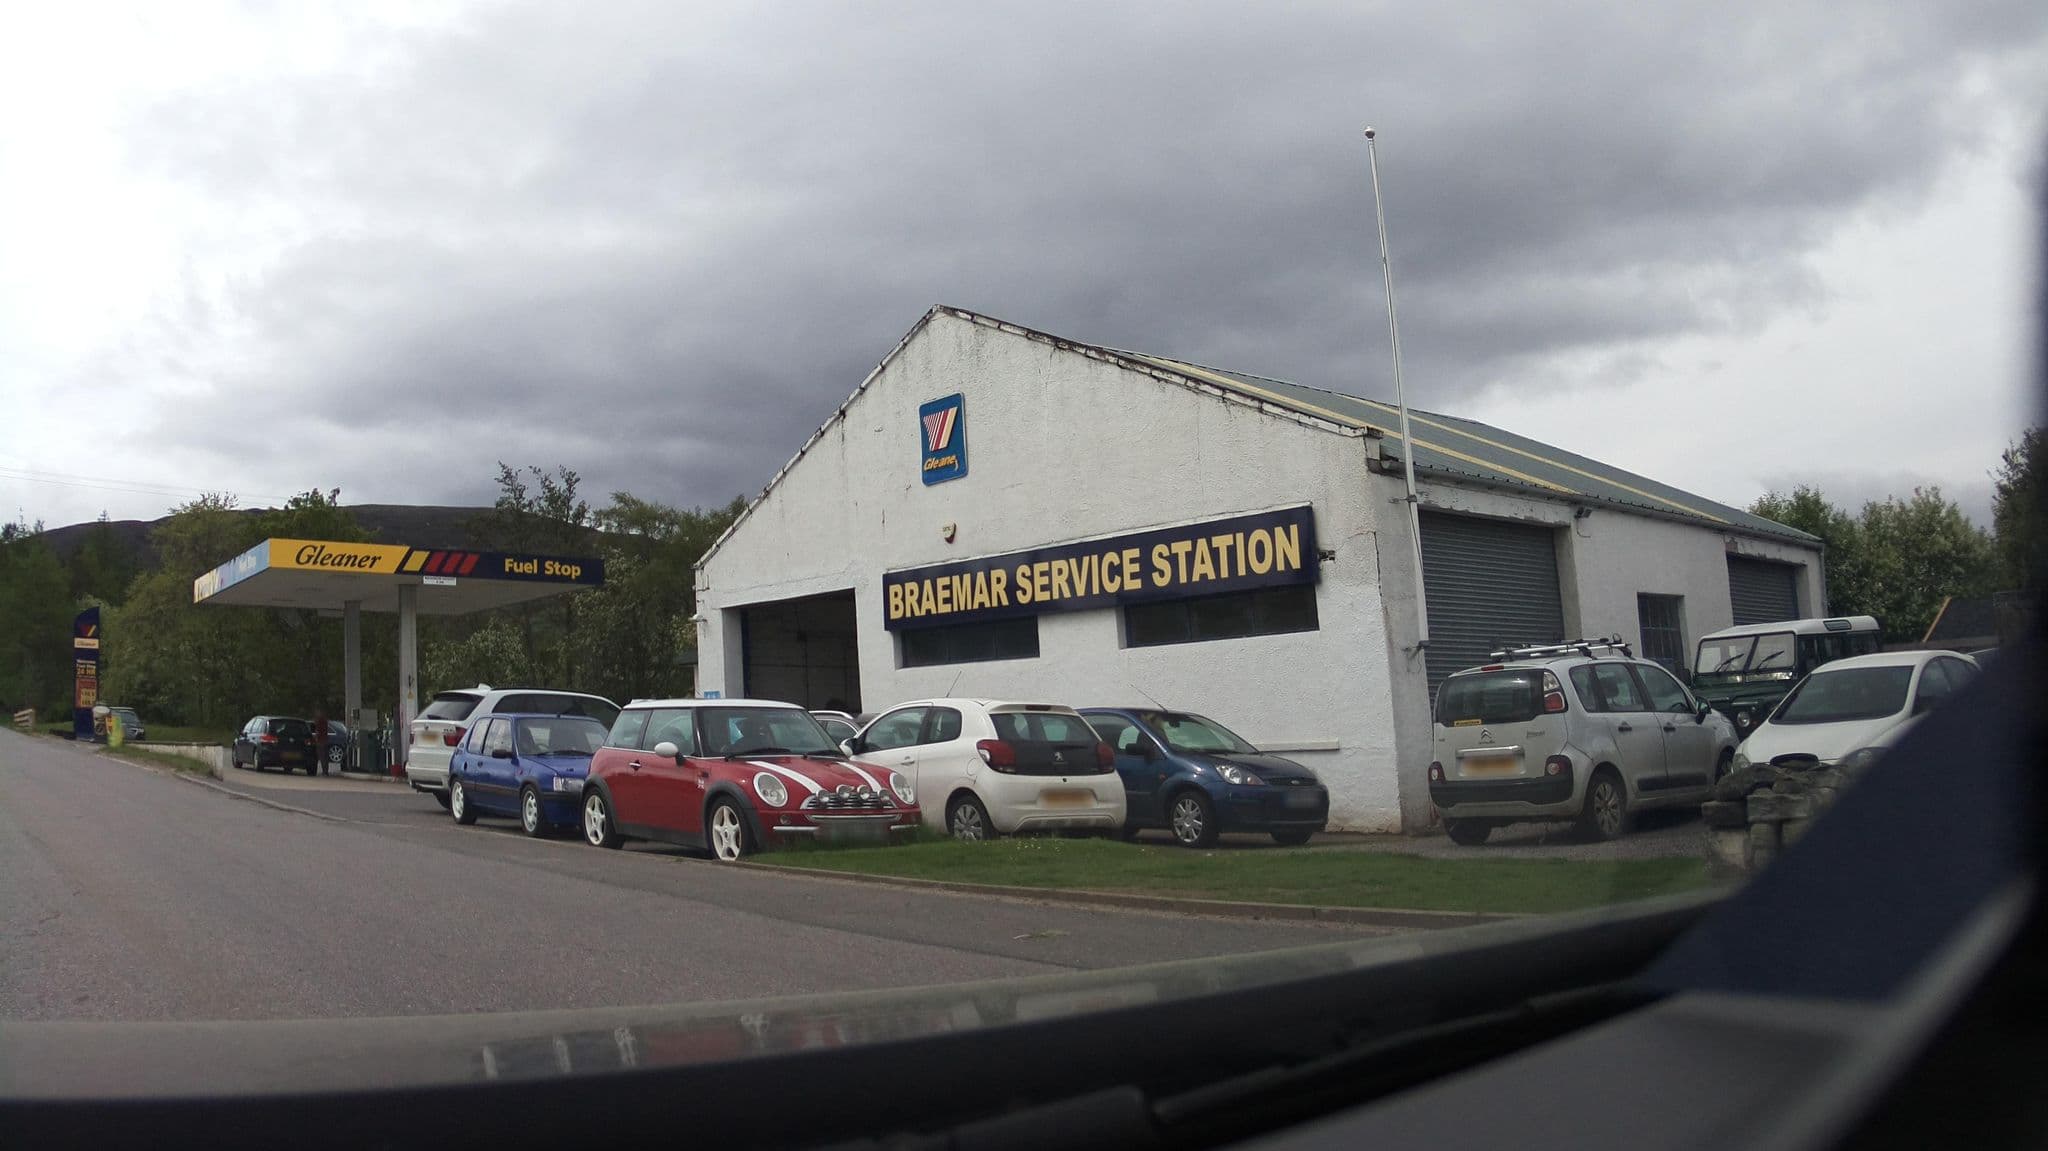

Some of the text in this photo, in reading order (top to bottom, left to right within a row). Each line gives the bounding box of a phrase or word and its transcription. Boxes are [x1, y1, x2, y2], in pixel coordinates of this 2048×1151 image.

[295, 544, 382, 569] Gleaner
[504, 557, 581, 578] Fuel Stop
[888, 523, 1301, 620] BRAEMAR SERVICE STATION
